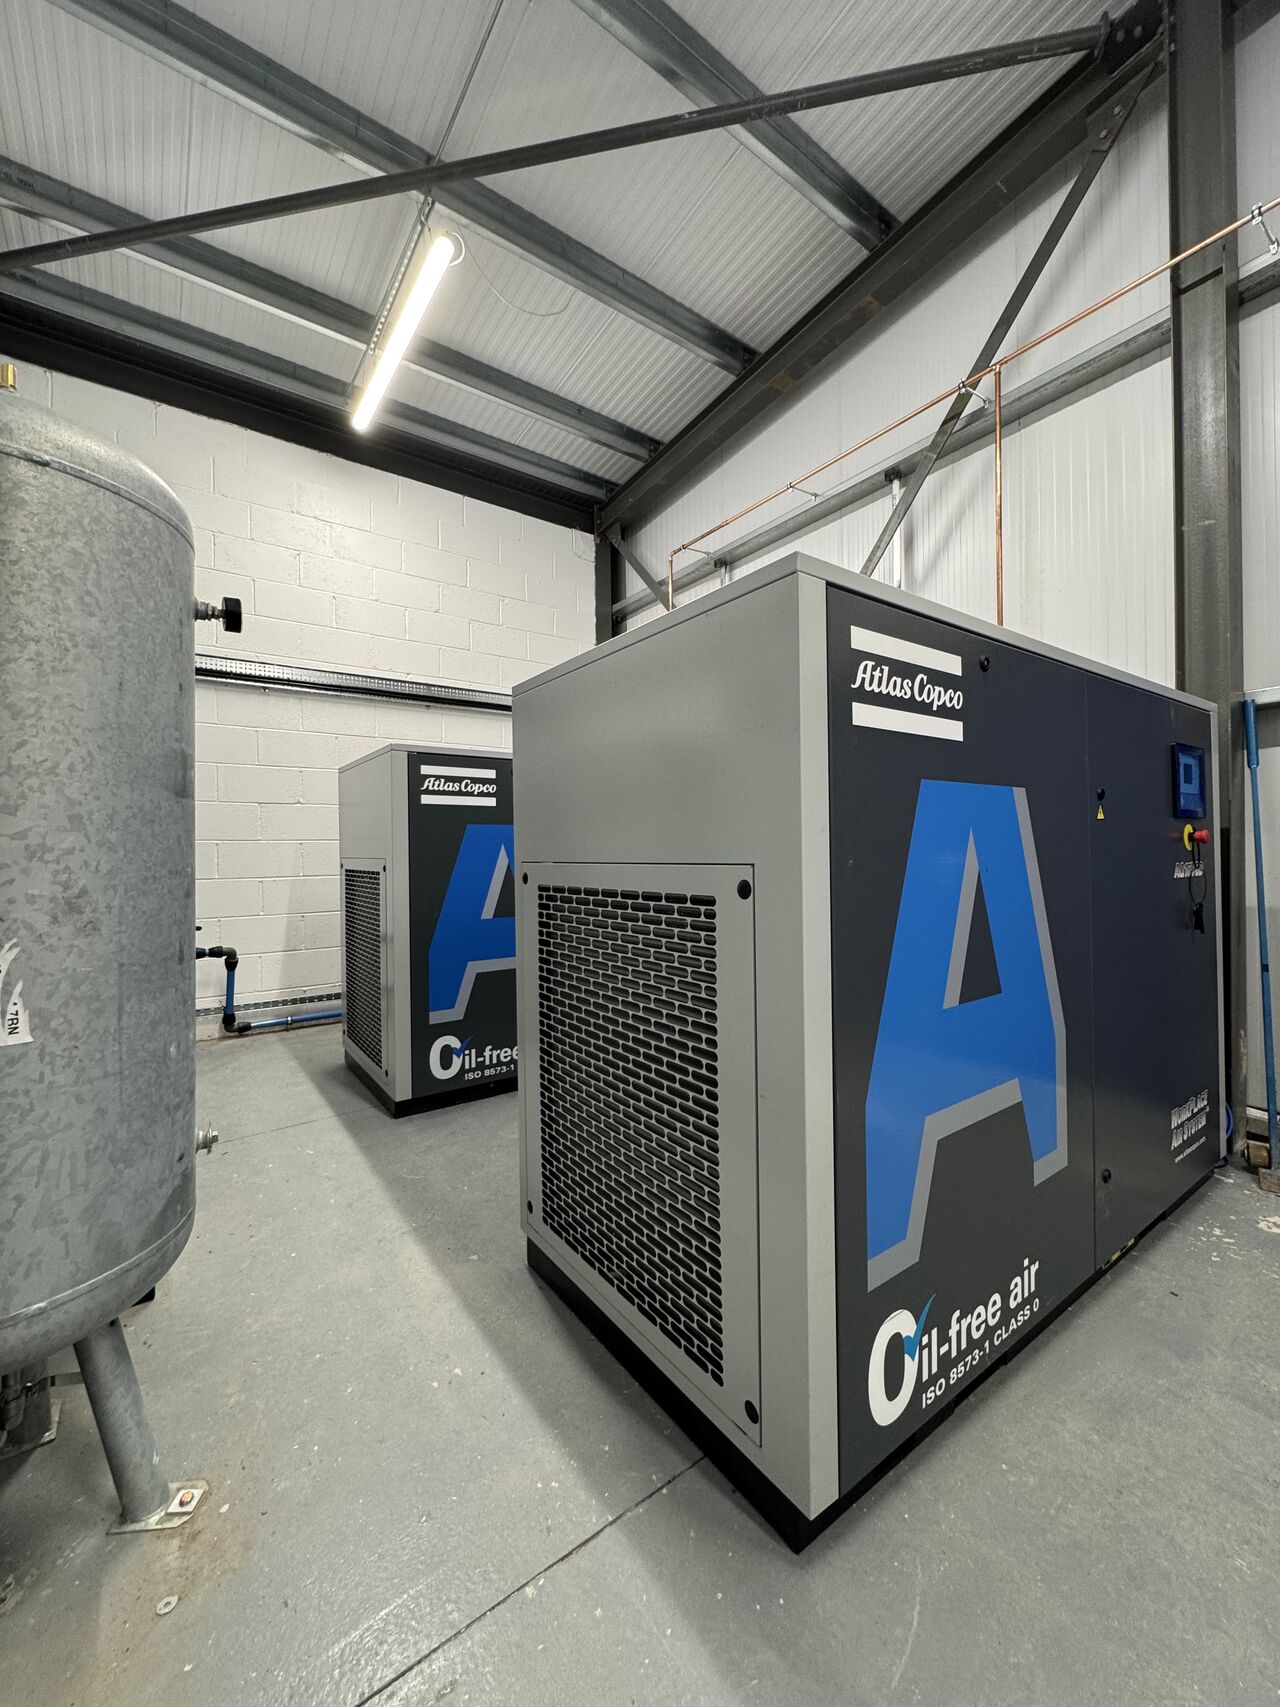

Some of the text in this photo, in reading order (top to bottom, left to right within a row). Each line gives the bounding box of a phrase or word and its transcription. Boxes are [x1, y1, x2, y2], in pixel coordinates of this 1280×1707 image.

[851, 660, 963, 710] Atlas Copco
[421, 777, 496, 795] Atlas Copco
[464, 1064, 515, 1080] ISO 8573-1
[868, 1257, 1039, 1426] Oil-free air
[922, 1298, 1040, 1409] ISO 8573-1 CLASS 0
